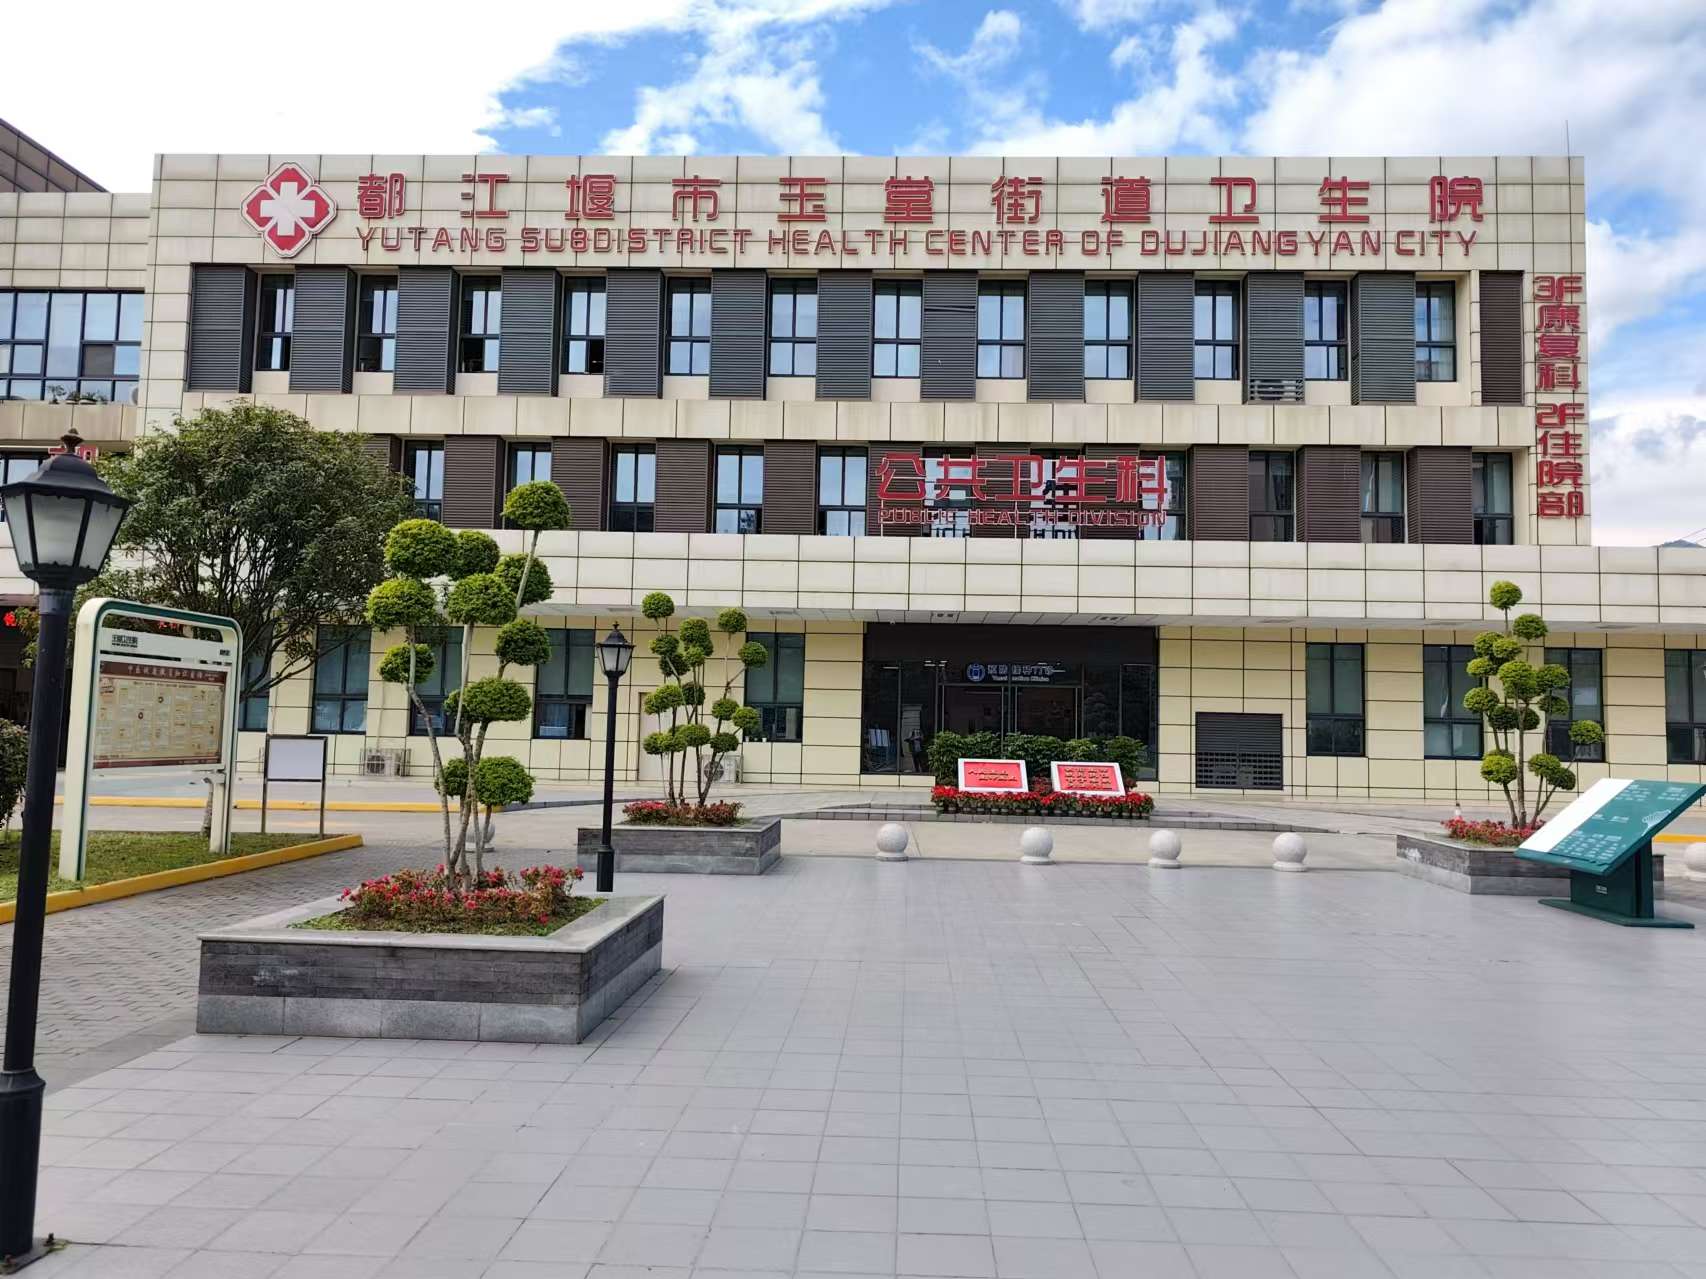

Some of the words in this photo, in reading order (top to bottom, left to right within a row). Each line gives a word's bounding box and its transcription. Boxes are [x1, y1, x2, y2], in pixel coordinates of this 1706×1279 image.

[358, 174, 1484, 222] 都江堰市玉堂街道卫生院
[356, 227, 508, 252] YUTANG
[521, 227, 752, 254] SUBDISTRICT
[768, 229, 908, 256] HEALTH
[921, 229, 1064, 256] CENTER
[1081, 230, 1123, 257] OF
[1140, 230, 1381, 257] DUJIANGYAN
[1395, 230, 1478, 257] CITY
[875, 452, 1168, 503] 公共卫生科
[877, 507, 957, 525] PUBLIC
[970, 508, 1064, 526] HEALTH
[1069, 509, 1169, 528] DIVISION
